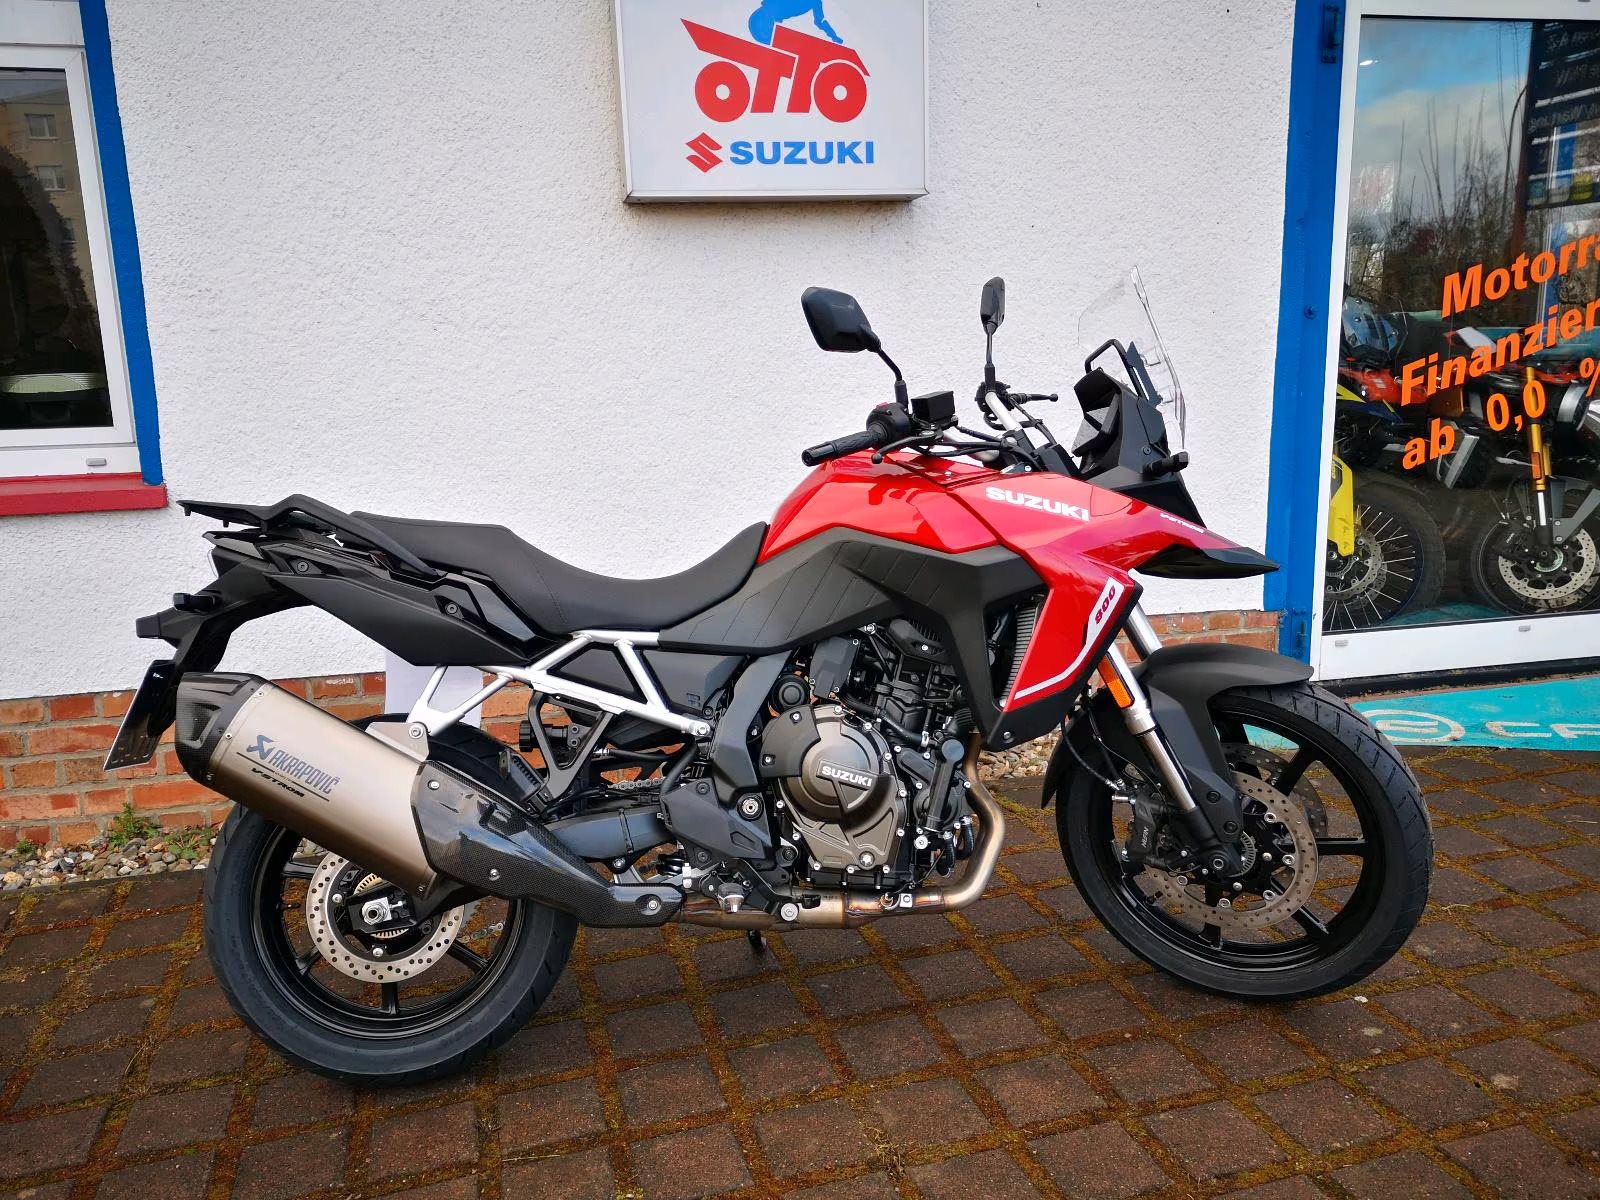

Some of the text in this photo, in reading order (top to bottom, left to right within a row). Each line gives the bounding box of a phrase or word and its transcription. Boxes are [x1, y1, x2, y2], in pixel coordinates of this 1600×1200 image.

[681, 19, 870, 122] OTTO
[730, 140, 874, 165] SUZUKI
[1441, 235, 1600, 319] Motorr
[1402, 418, 1456, 470] ab
[1486, 380, 1546, 431] 0,0
[985, 486, 1091, 522] SUZUKI
[1095, 584, 1116, 624] 800
[821, 764, 874, 787] SUZUKI
